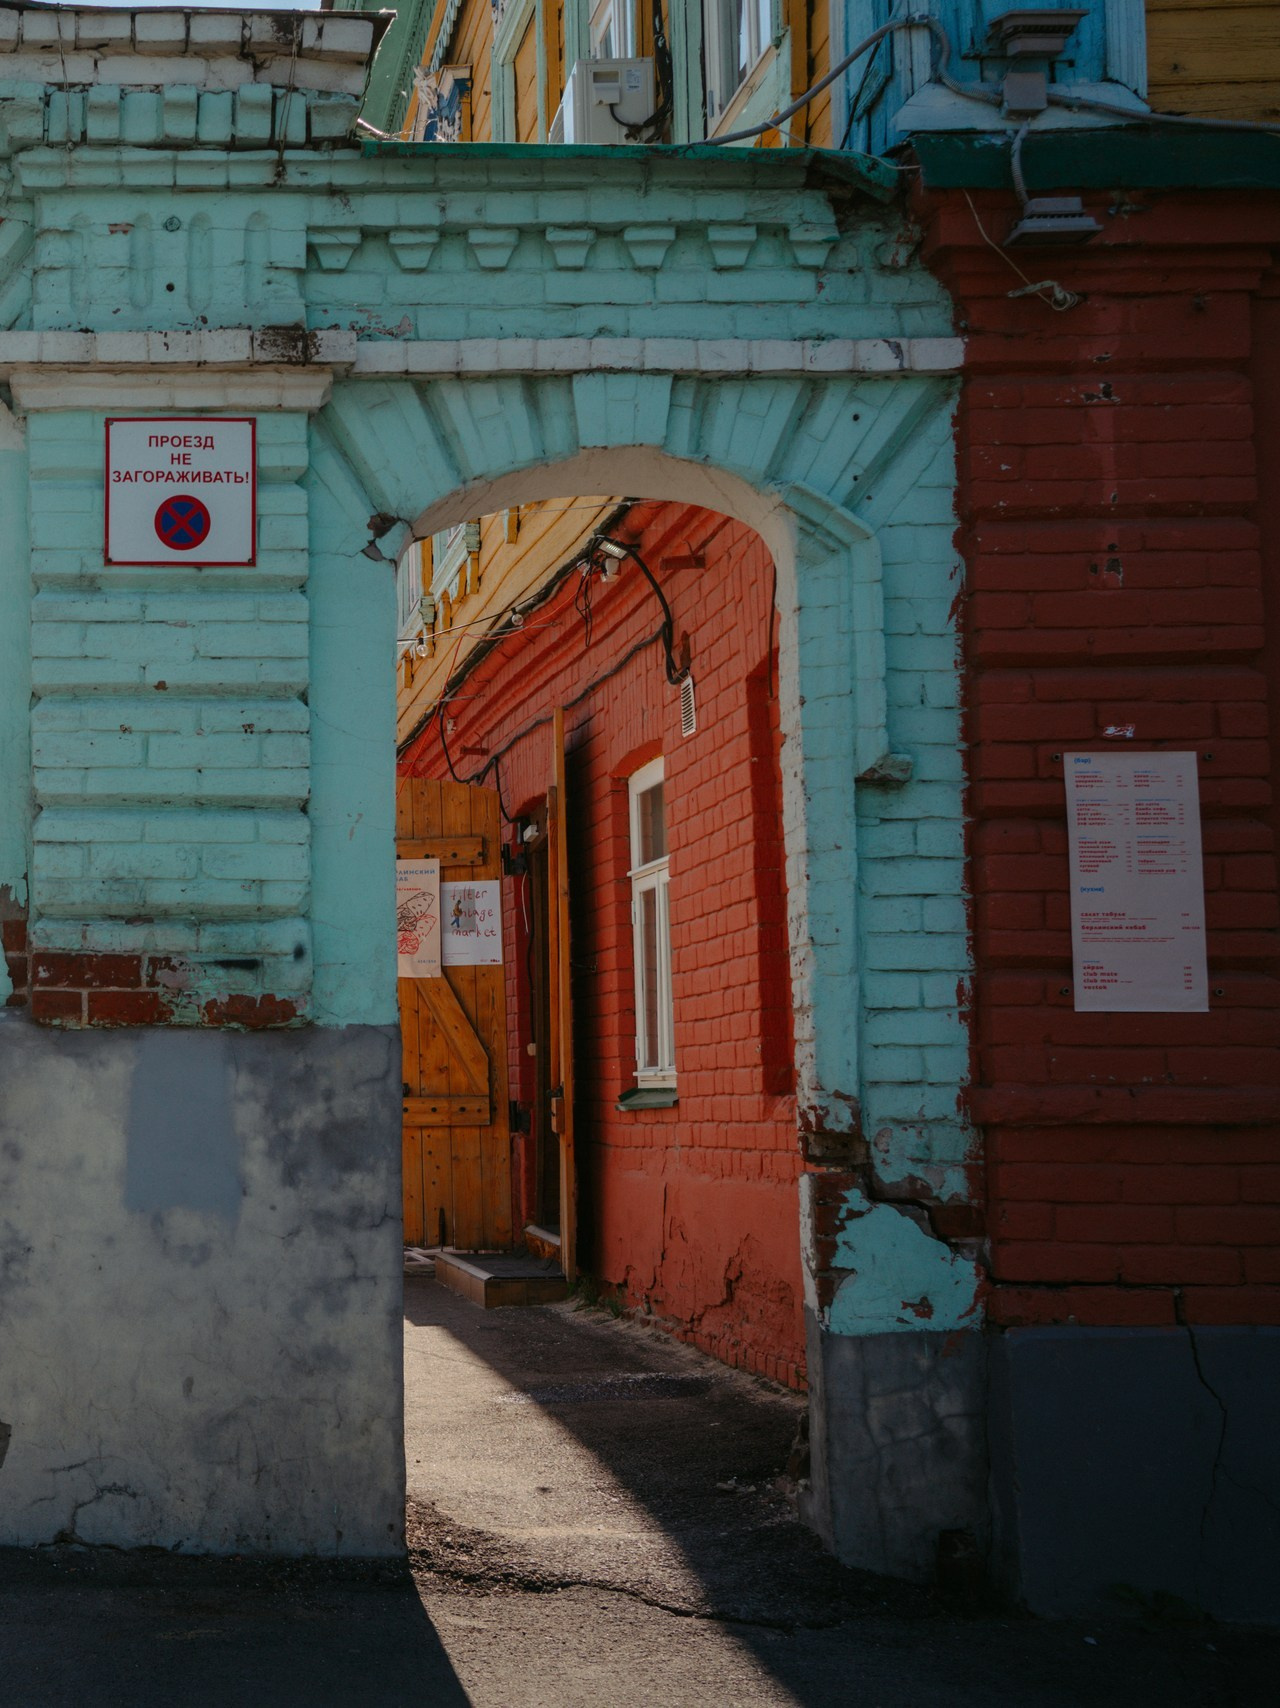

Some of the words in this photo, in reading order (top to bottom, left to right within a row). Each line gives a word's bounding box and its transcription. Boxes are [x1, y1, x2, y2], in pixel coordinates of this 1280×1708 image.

[148, 435, 215, 450] ПРОЕЗД
[170, 453, 192, 465] НЕ
[112, 470, 249, 484] ЗАГОРАЖИВАТЬ!
[450, 885, 488, 901] filter
[452, 923, 497, 938] market
